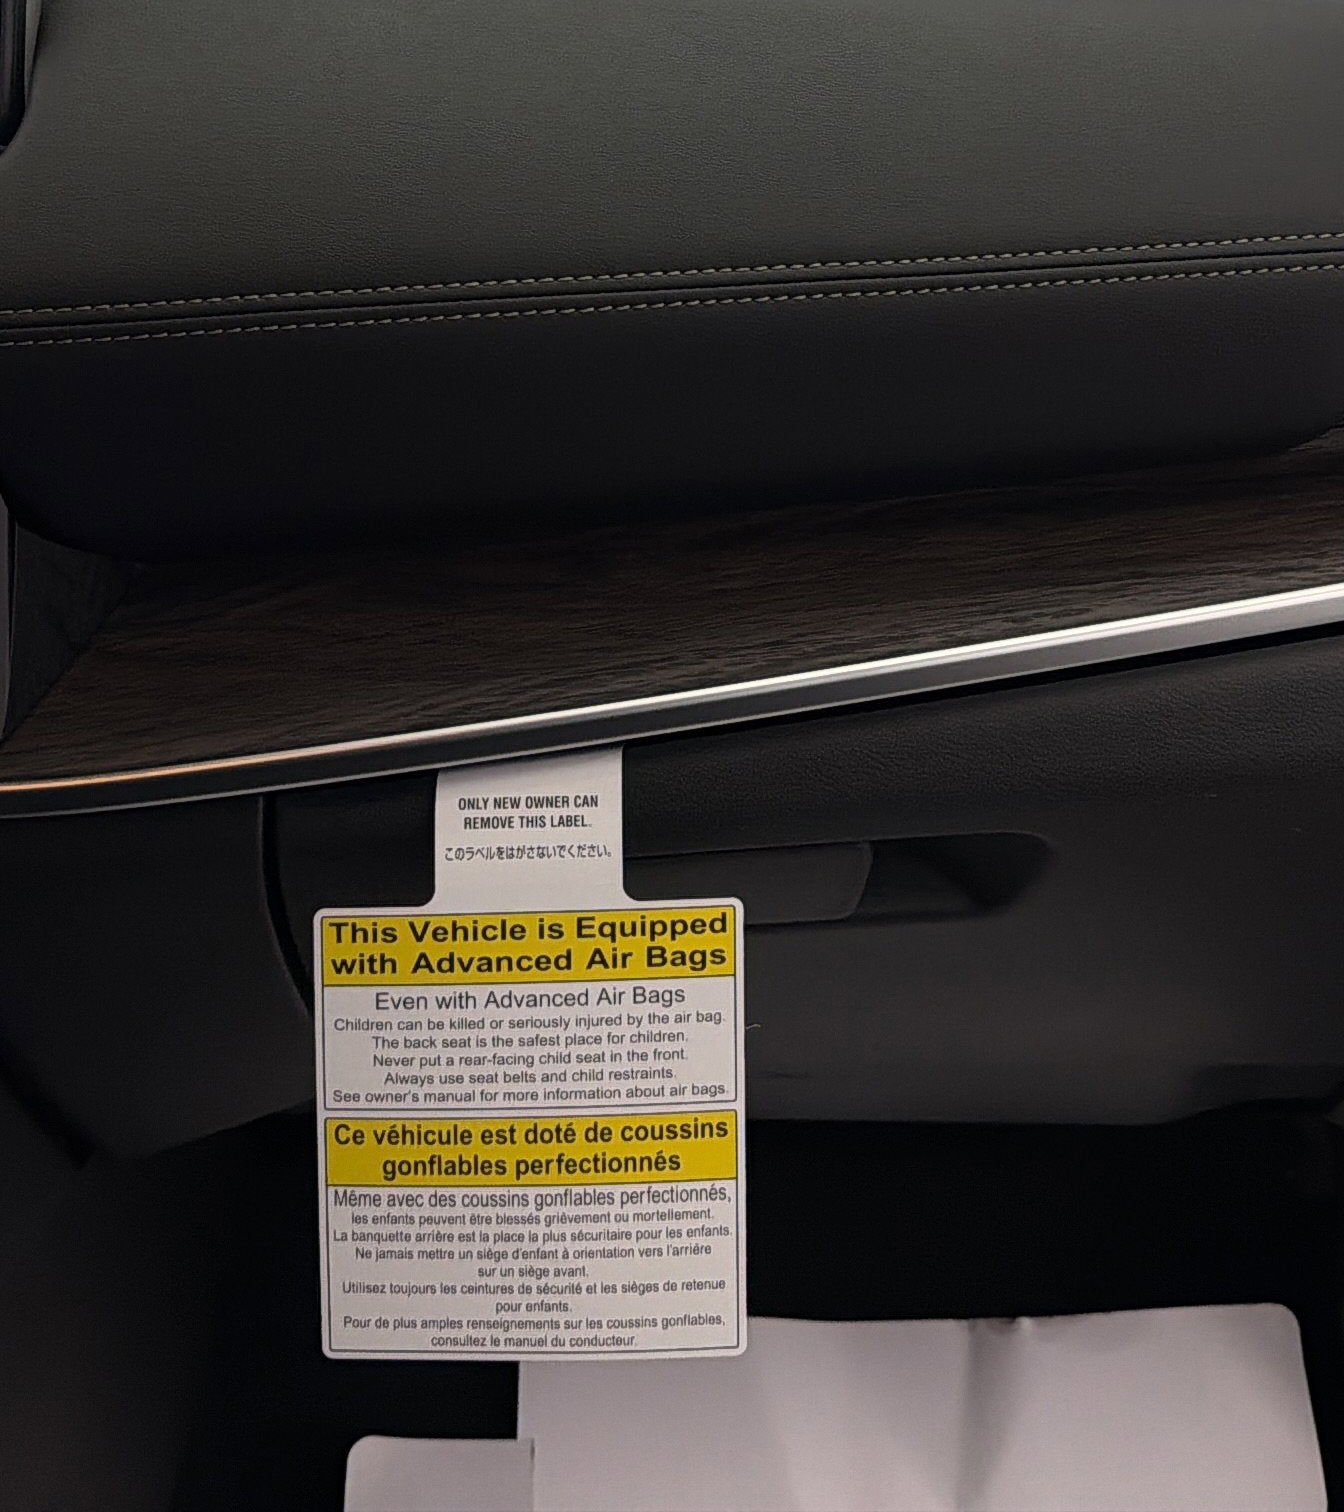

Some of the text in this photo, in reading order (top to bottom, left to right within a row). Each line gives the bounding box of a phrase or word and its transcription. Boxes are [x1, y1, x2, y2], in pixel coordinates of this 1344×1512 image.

[458, 794, 598, 810] ONLY NEW OWNER CAN
[463, 815, 514, 829] REMOVE
[518, 814, 546, 828] THIS
[328, 911, 727, 943] This Vehicle is Equipped
[330, 945, 726, 974] with Advanced Air Bags
[375, 985, 685, 1010] Even with Advanced Air Bags
[333, 1017, 393, 1031] Children
[397, 1020, 422, 1030] can
[427, 1017, 444, 1030] be
[449, 1016, 485, 1030] killed
[489, 1019, 504, 1029] or
[507, 1014, 570, 1029] seriously
[575, 1012, 622, 1029] injured
[626, 1012, 643, 1028] by
[647, 1011, 669, 1025] the
[673, 1010, 692, 1023] air
[371, 1035, 399, 1049] The
[403, 1035, 437, 1049] back
[441, 1035, 471, 1048] seat
[475, 1034, 487, 1048] is
[491, 1034, 513, 1047] the
[517, 1033, 560, 1047] safest
[564, 1032, 602, 1048] place
[606, 1031, 625, 1045] for
[373, 1053, 415, 1067] Never
[419, 1053, 441, 1069] put
[445, 1056, 454, 1066] a
[458, 1052, 534, 1066] rear-facing
[538, 1050, 571, 1065] child
[575, 1050, 606, 1063] seat
[609, 1049, 622, 1063] in
[626, 1048, 648, 1062] the
[383, 1071, 434, 1087] Always
[438, 1074, 464, 1084] use
[468, 1071, 498, 1084] seat
[502, 1070, 536, 1083] belts
[540, 1069, 567, 1083] and
[571, 1068, 603, 1082] child
[332, 1089, 360, 1102] See
[423, 1089, 475, 1103] manual
[479, 1088, 499, 1102] for
[502, 1090, 538, 1102] more
[543, 1086, 621, 1101] information
[625, 1084, 665, 1098] about
[669, 1083, 687, 1096] air
[334, 1116, 728, 1145] Ce véhicule est doté de coussins
[382, 1149, 680, 1180] gonflables perfectionnés
[333, 1188, 381, 1207] Même
[386, 1193, 424, 1207] avec
[427, 1189, 456, 1207] des
[461, 1189, 529, 1207] coussins
[533, 1187, 614, 1208] gonflables
